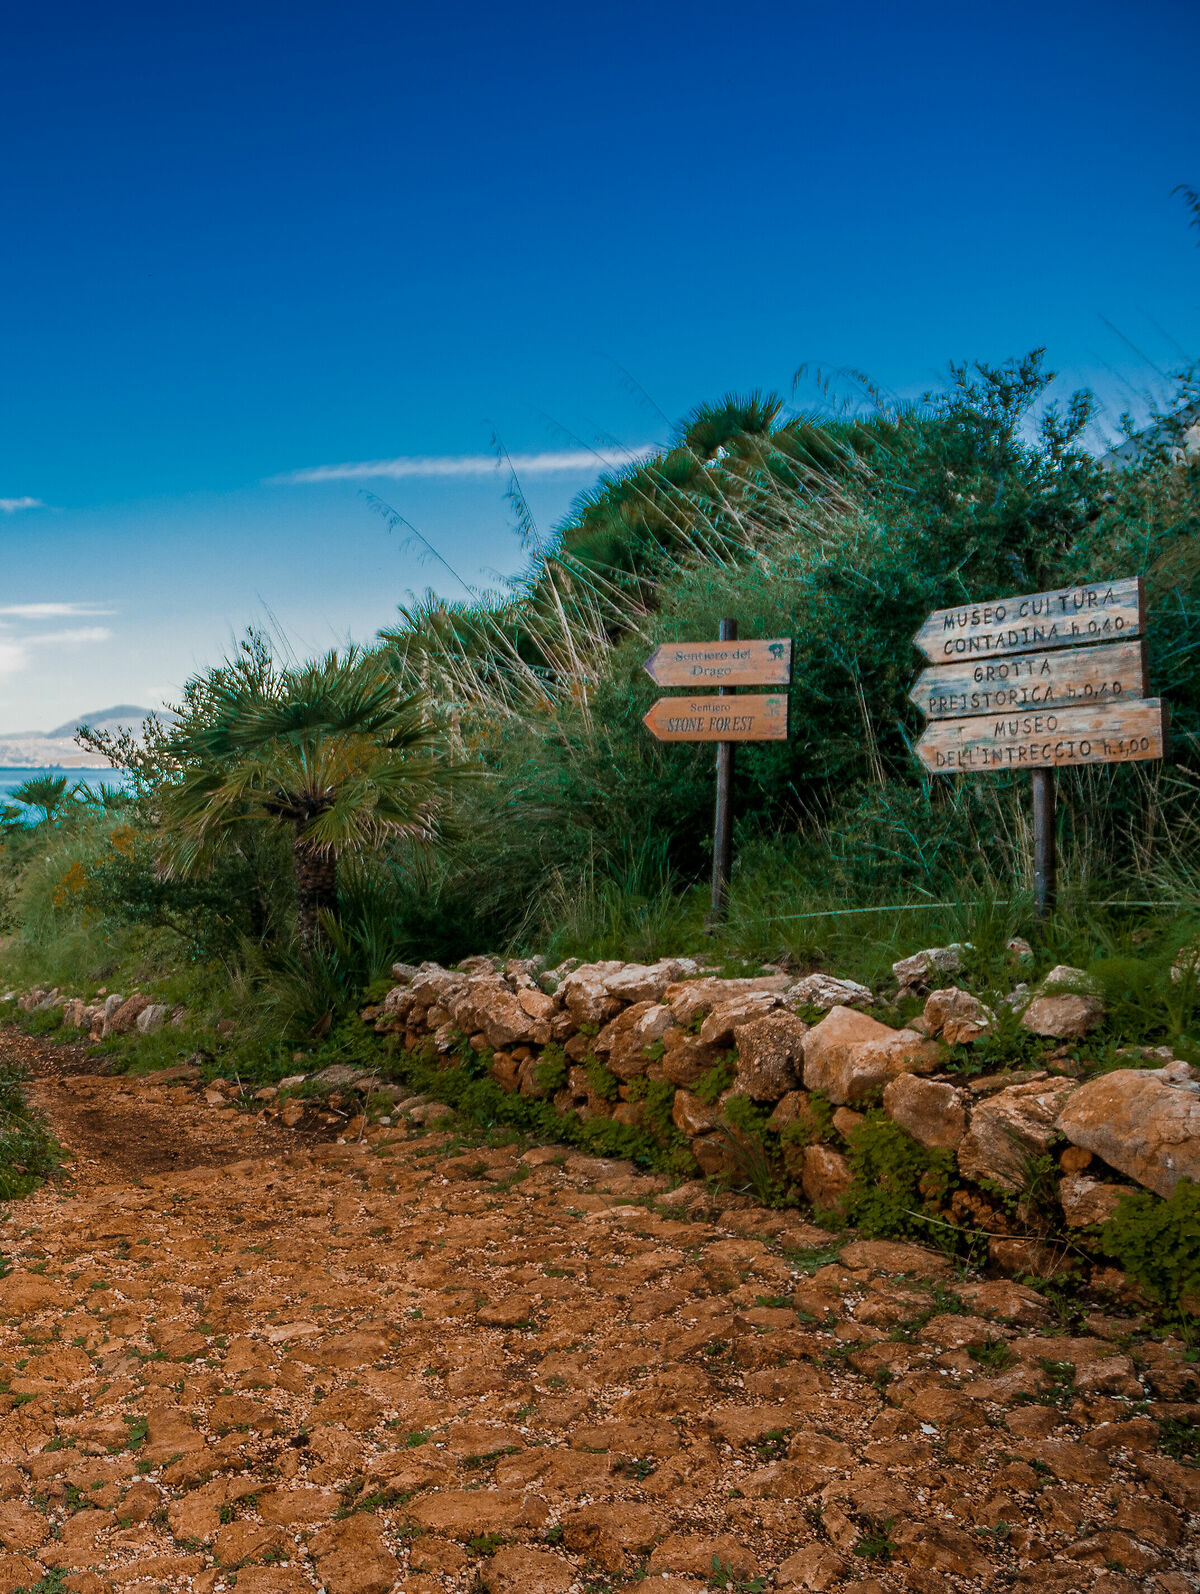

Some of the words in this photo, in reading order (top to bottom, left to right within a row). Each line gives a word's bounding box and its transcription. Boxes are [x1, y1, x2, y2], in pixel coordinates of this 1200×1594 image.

[943, 606, 1007, 631] MUSEO
[1019, 587, 1115, 618] CULTURA
[943, 623, 1058, 655] CONTADINA
[675, 650, 728, 662] Sentiero
[732, 648, 751, 660] del
[691, 665, 732, 679] Drago
[974, 658, 1051, 683] GROTTA
[690, 702, 731, 714] Sentiero
[928, 686, 1054, 713] PREISTORICA
[667, 716, 704, 733] STONE
[708, 715, 755, 732] FOREST
[994, 715, 1058, 737] MUSEO
[935, 740, 1092, 768] DELL'INTRECCIO
